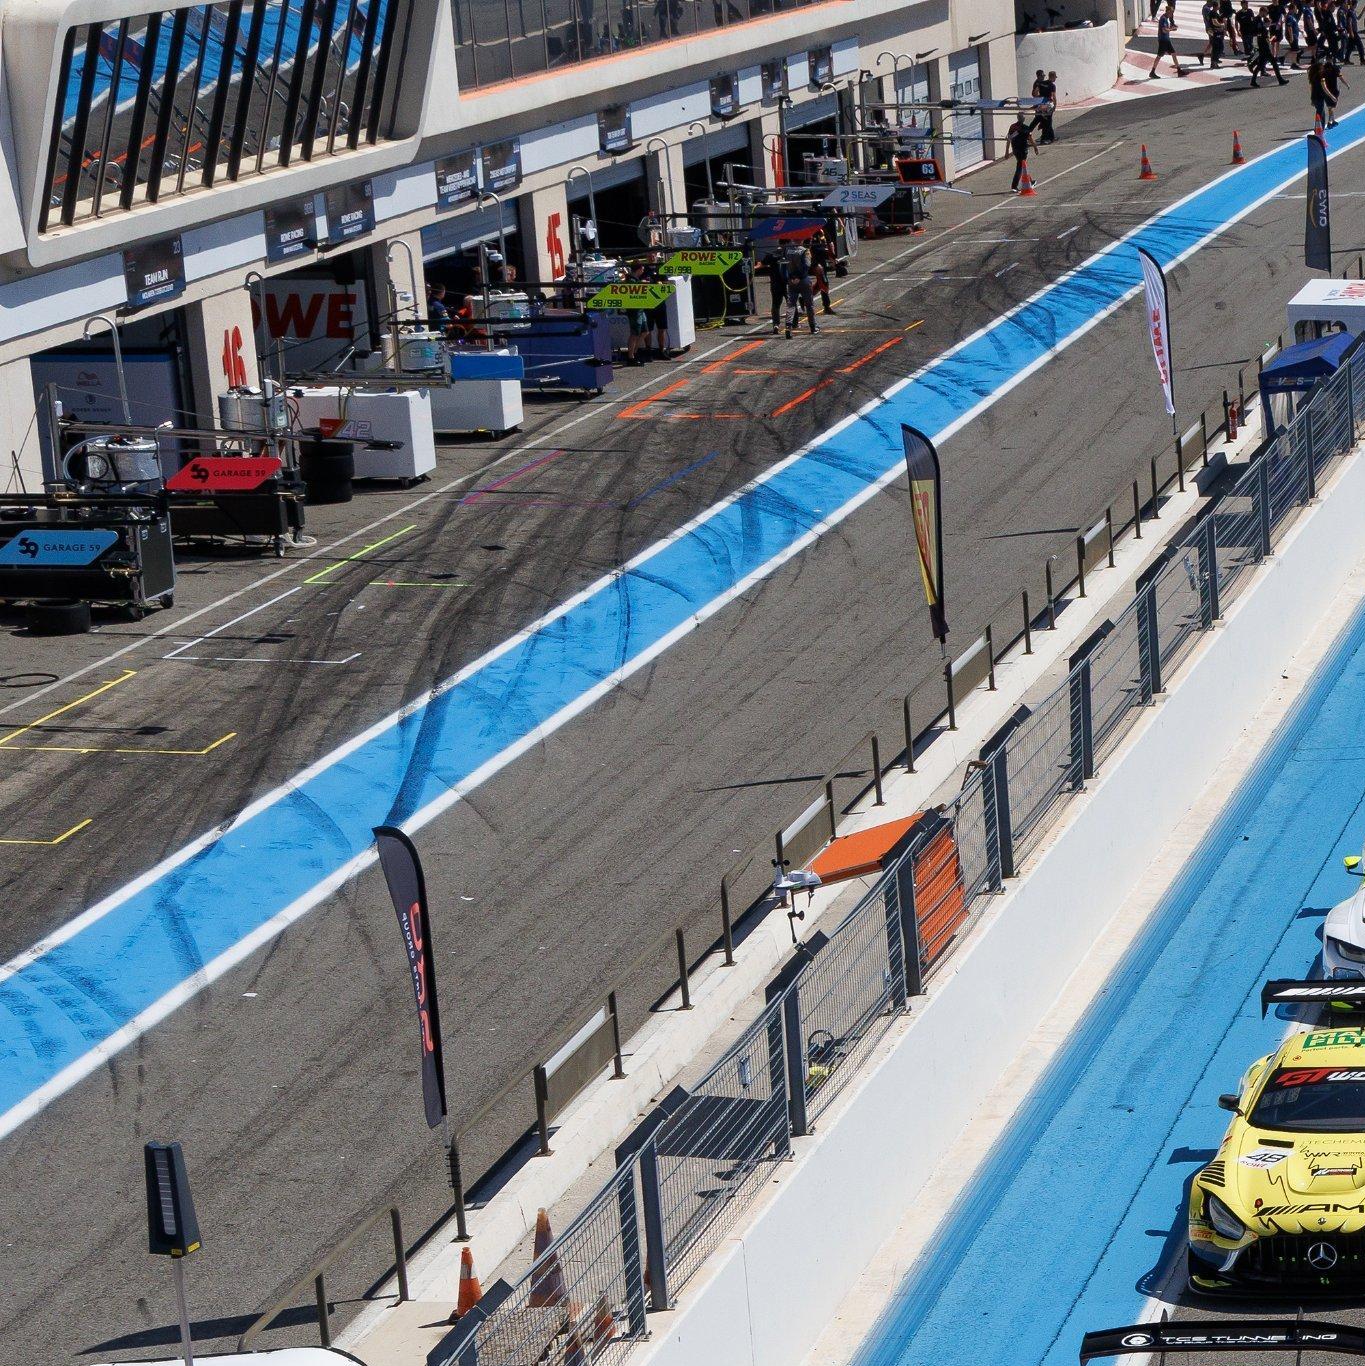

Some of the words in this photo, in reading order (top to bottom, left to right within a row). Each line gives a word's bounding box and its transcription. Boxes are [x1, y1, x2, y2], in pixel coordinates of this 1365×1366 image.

[922, 164, 934, 174] 63
[852, 191, 876, 199] SEAS
[681, 252, 716, 261] ROWE
[610, 286, 647, 295] ROWE
[43, 544, 86, 552] GARAGE
